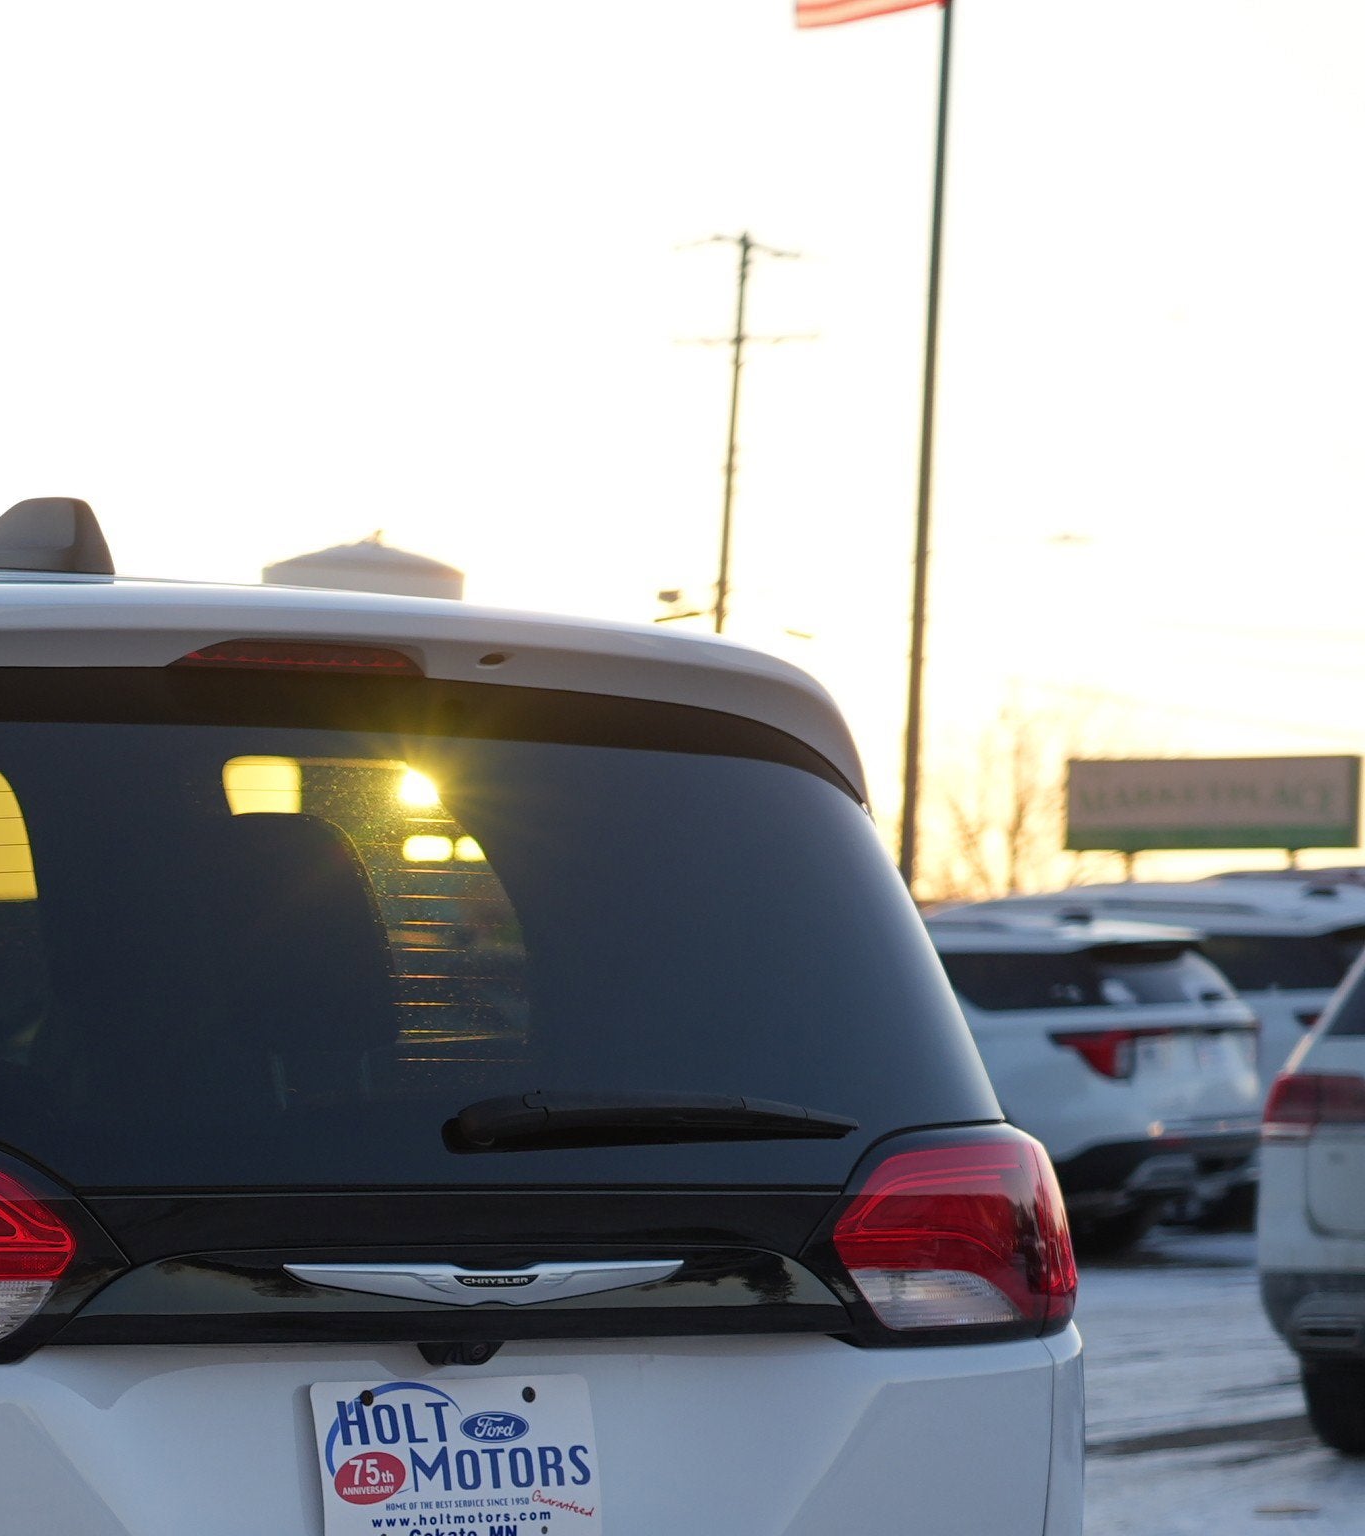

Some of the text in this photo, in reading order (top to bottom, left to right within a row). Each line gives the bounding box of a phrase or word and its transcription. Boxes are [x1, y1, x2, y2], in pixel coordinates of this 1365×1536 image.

[336, 1400, 448, 1446] HOLT
[474, 1415, 516, 1437] Ford
[349, 1458, 394, 1486] 75th
[409, 1445, 591, 1493] MOTORS
[342, 1485, 394, 1496] ANNIVERSARY
[531, 1489, 595, 1517] Guaranteed
[385, 1497, 530, 1511] HOME OF THE BEST SERVICE SINCE 1950
[371, 1511, 552, 1528] www.holtmotors.com
